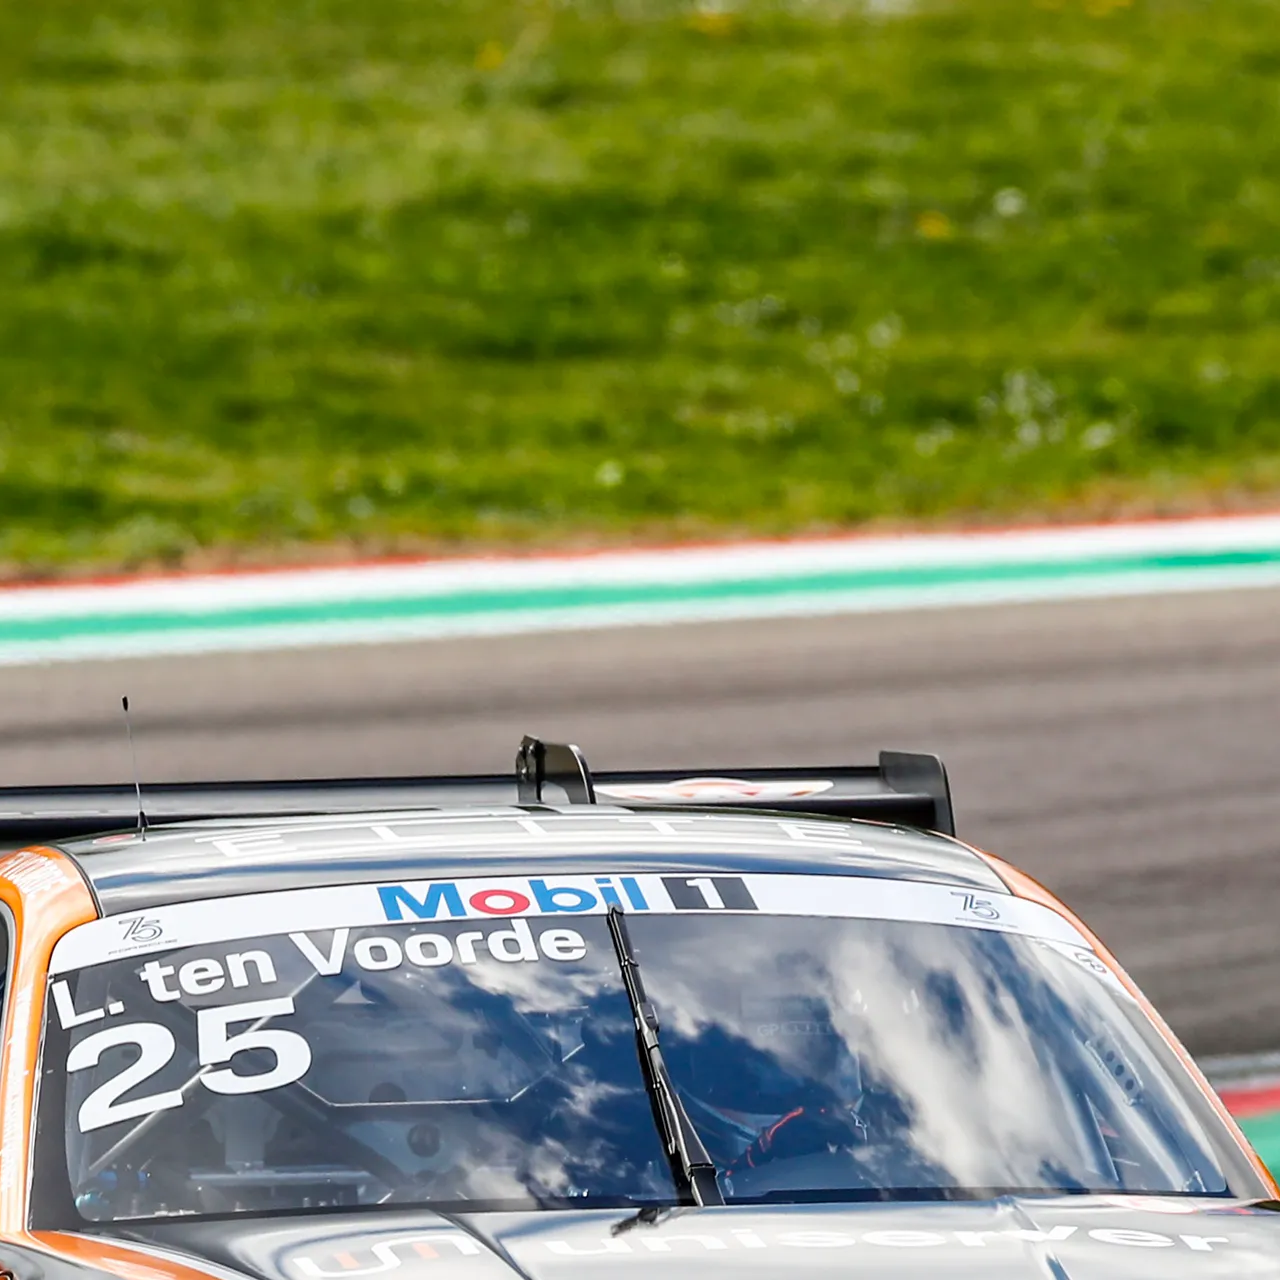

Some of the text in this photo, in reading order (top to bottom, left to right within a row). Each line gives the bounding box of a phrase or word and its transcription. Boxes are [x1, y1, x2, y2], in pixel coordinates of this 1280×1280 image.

[376, 876, 723, 921] Mobil 1
[52, 918, 587, 1030] L. ten Voorde
[65, 996, 312, 1133] 25
[544, 1225, 1230, 1256] uniserver
